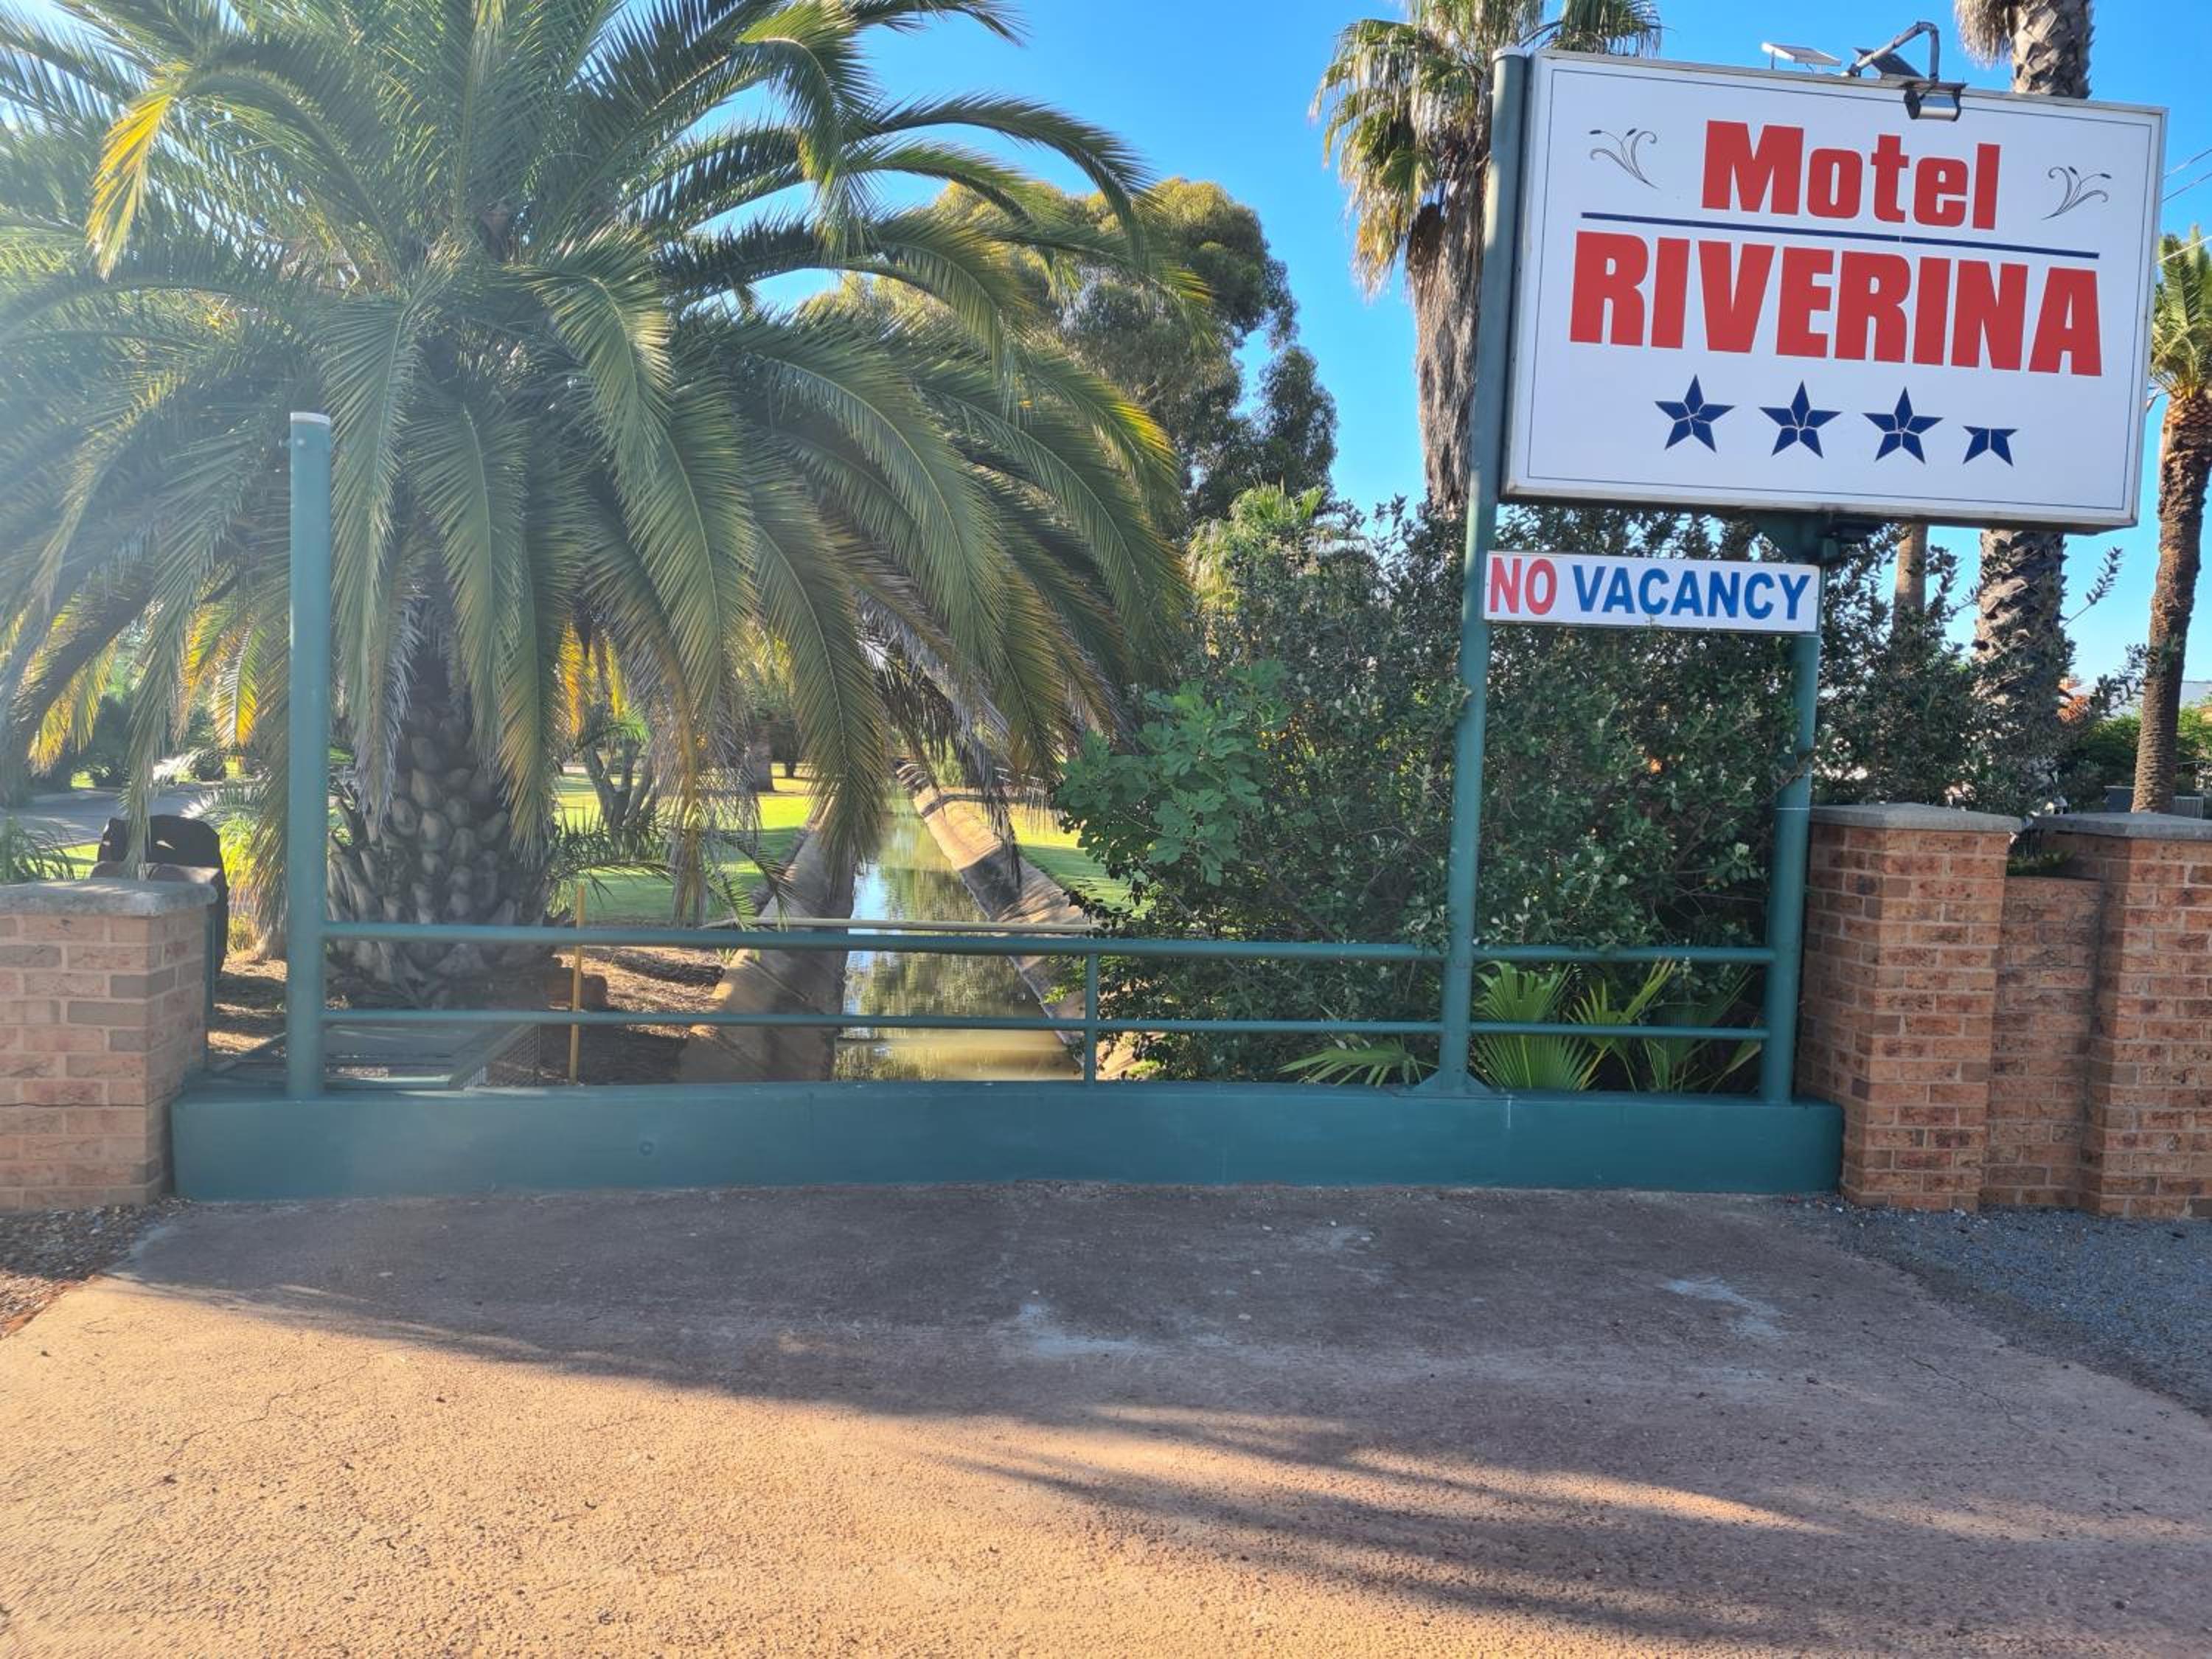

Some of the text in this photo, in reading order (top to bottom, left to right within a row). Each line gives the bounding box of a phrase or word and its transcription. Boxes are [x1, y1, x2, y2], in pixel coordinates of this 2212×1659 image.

[1702, 119, 2000, 231] Motel
[1569, 230, 2102, 377] RIVERINA
[1488, 556, 1812, 622] NO VACANCY
